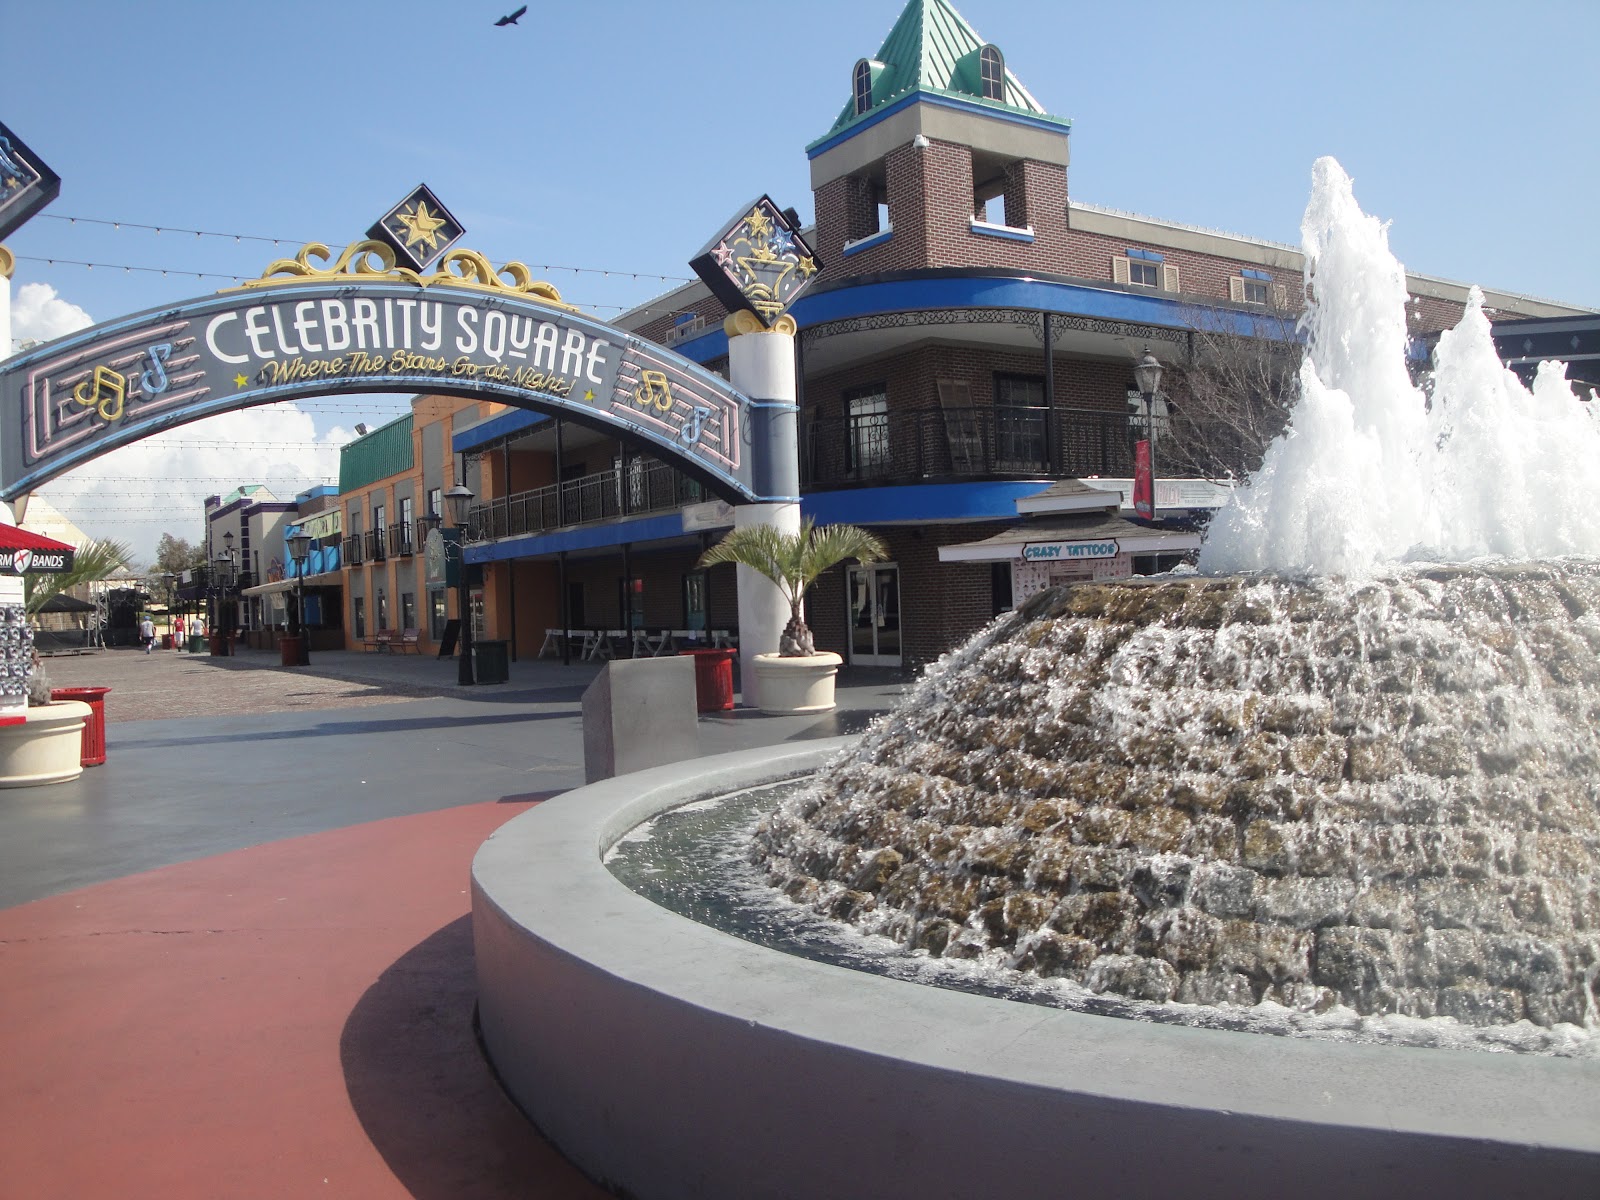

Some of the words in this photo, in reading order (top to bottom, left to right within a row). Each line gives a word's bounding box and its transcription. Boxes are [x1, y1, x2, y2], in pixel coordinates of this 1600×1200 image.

[206, 298, 442, 364] CELEBRITY
[455, 305, 610, 385] SQUARE
[262, 356, 346, 383] Where
[346, 351, 386, 373] The
[390, 349, 448, 371] Stars
[451, 355, 479, 376] Go
[484, 363, 510, 381] at
[512, 365, 577, 397] Night!
[32, 555, 64, 567] BANDS
[1025, 545, 1062, 558] CRAZY
[1066, 543, 1115, 557] TATTOOS
